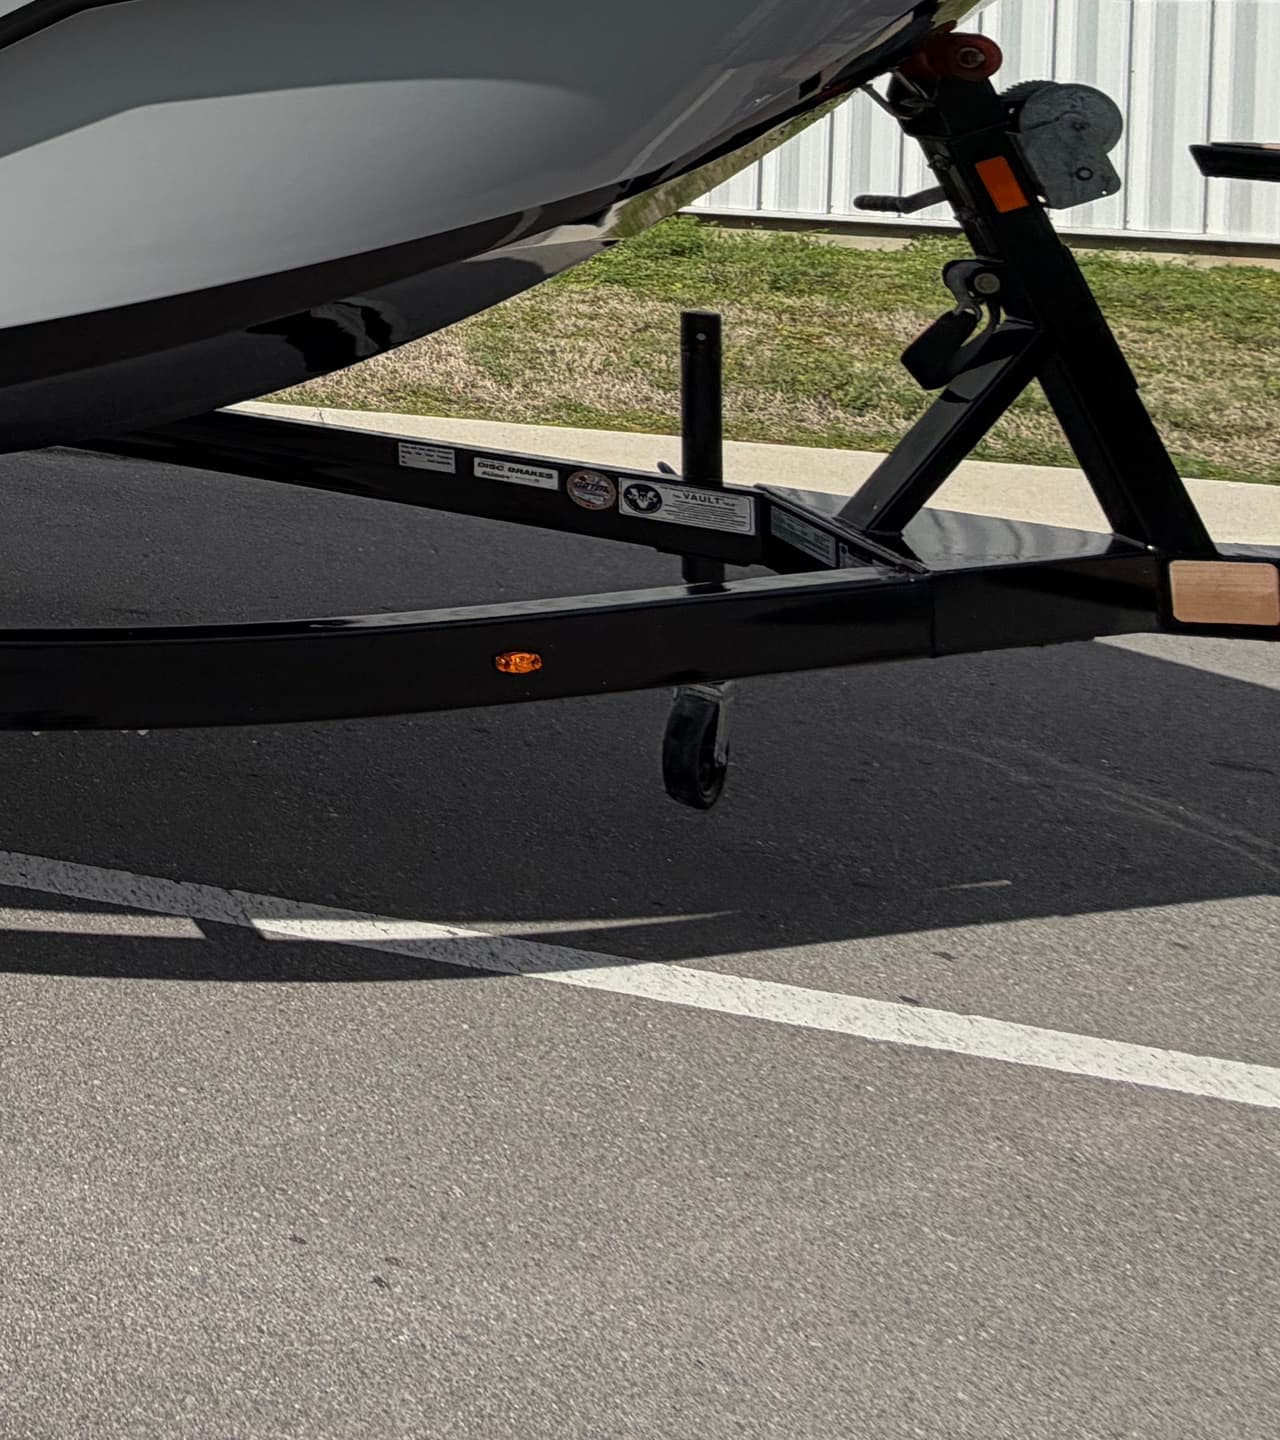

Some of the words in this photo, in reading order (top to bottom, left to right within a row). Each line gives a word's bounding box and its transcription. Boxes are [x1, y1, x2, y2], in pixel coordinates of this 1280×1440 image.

[477, 461, 505, 472] DISC
[507, 466, 554, 480] BRAKES
[682, 492, 724, 505] VAULT
